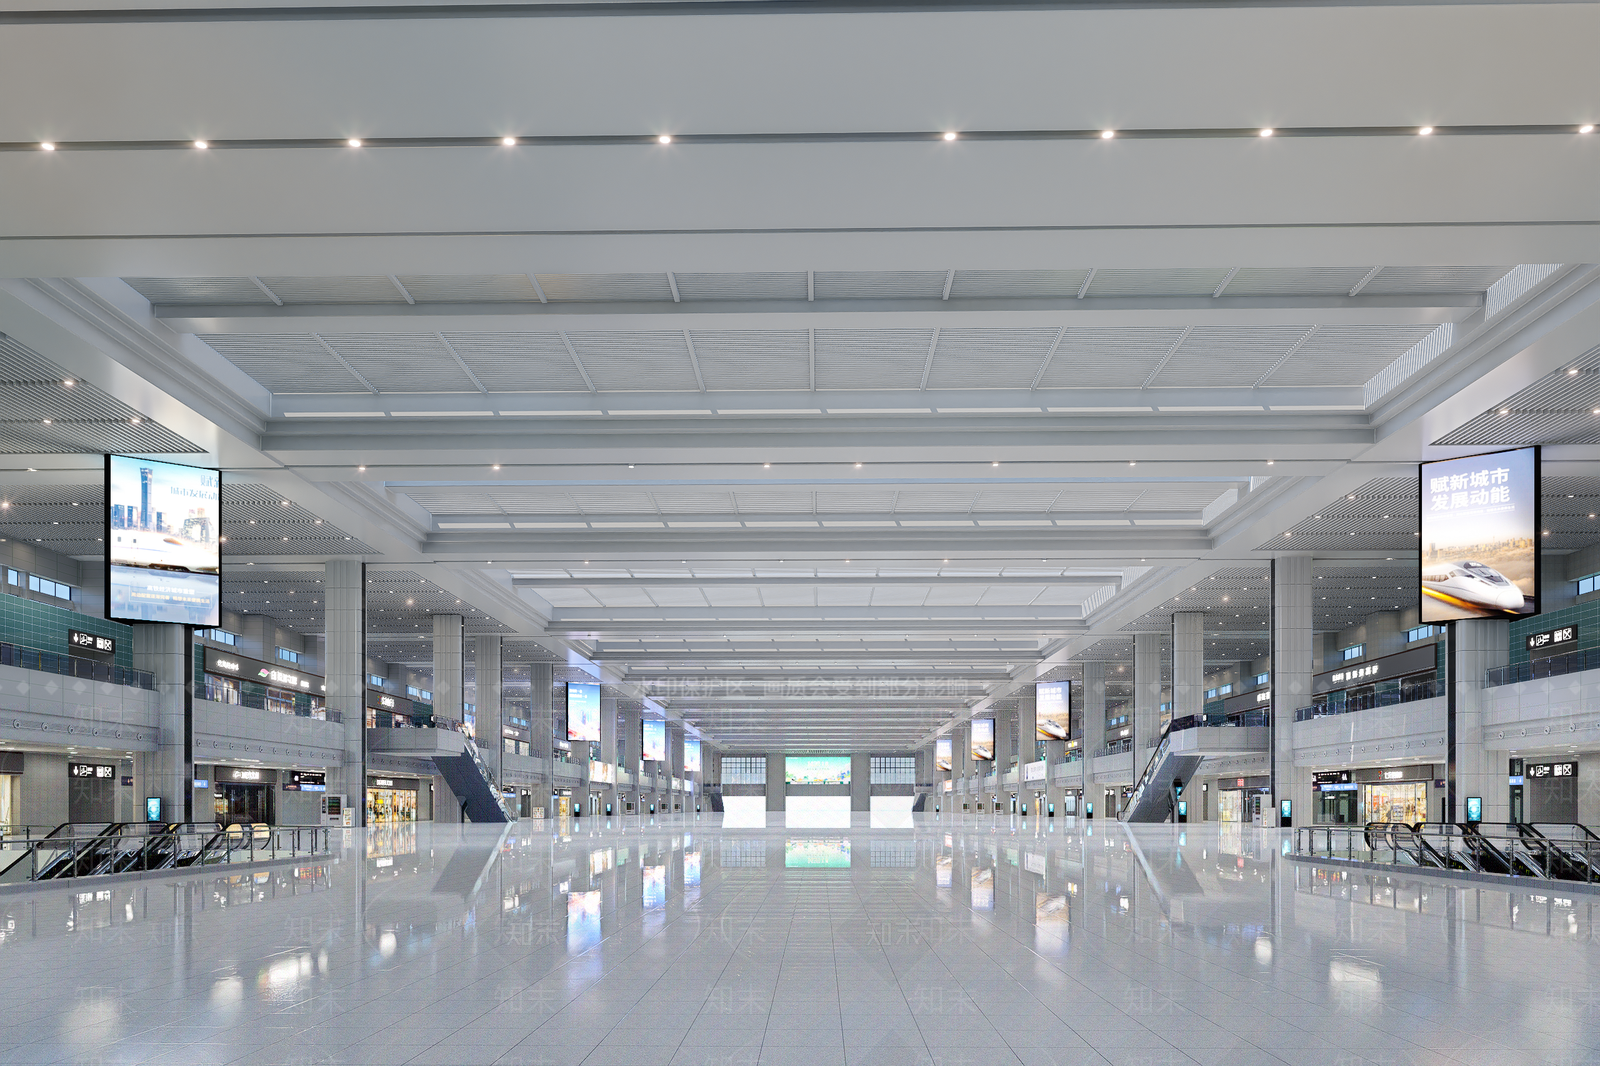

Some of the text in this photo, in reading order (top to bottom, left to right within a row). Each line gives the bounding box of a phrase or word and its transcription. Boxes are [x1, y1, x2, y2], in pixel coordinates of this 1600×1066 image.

[1430, 467, 1510, 494] 赋新城市
[1430, 485, 1511, 512] 发展动能
